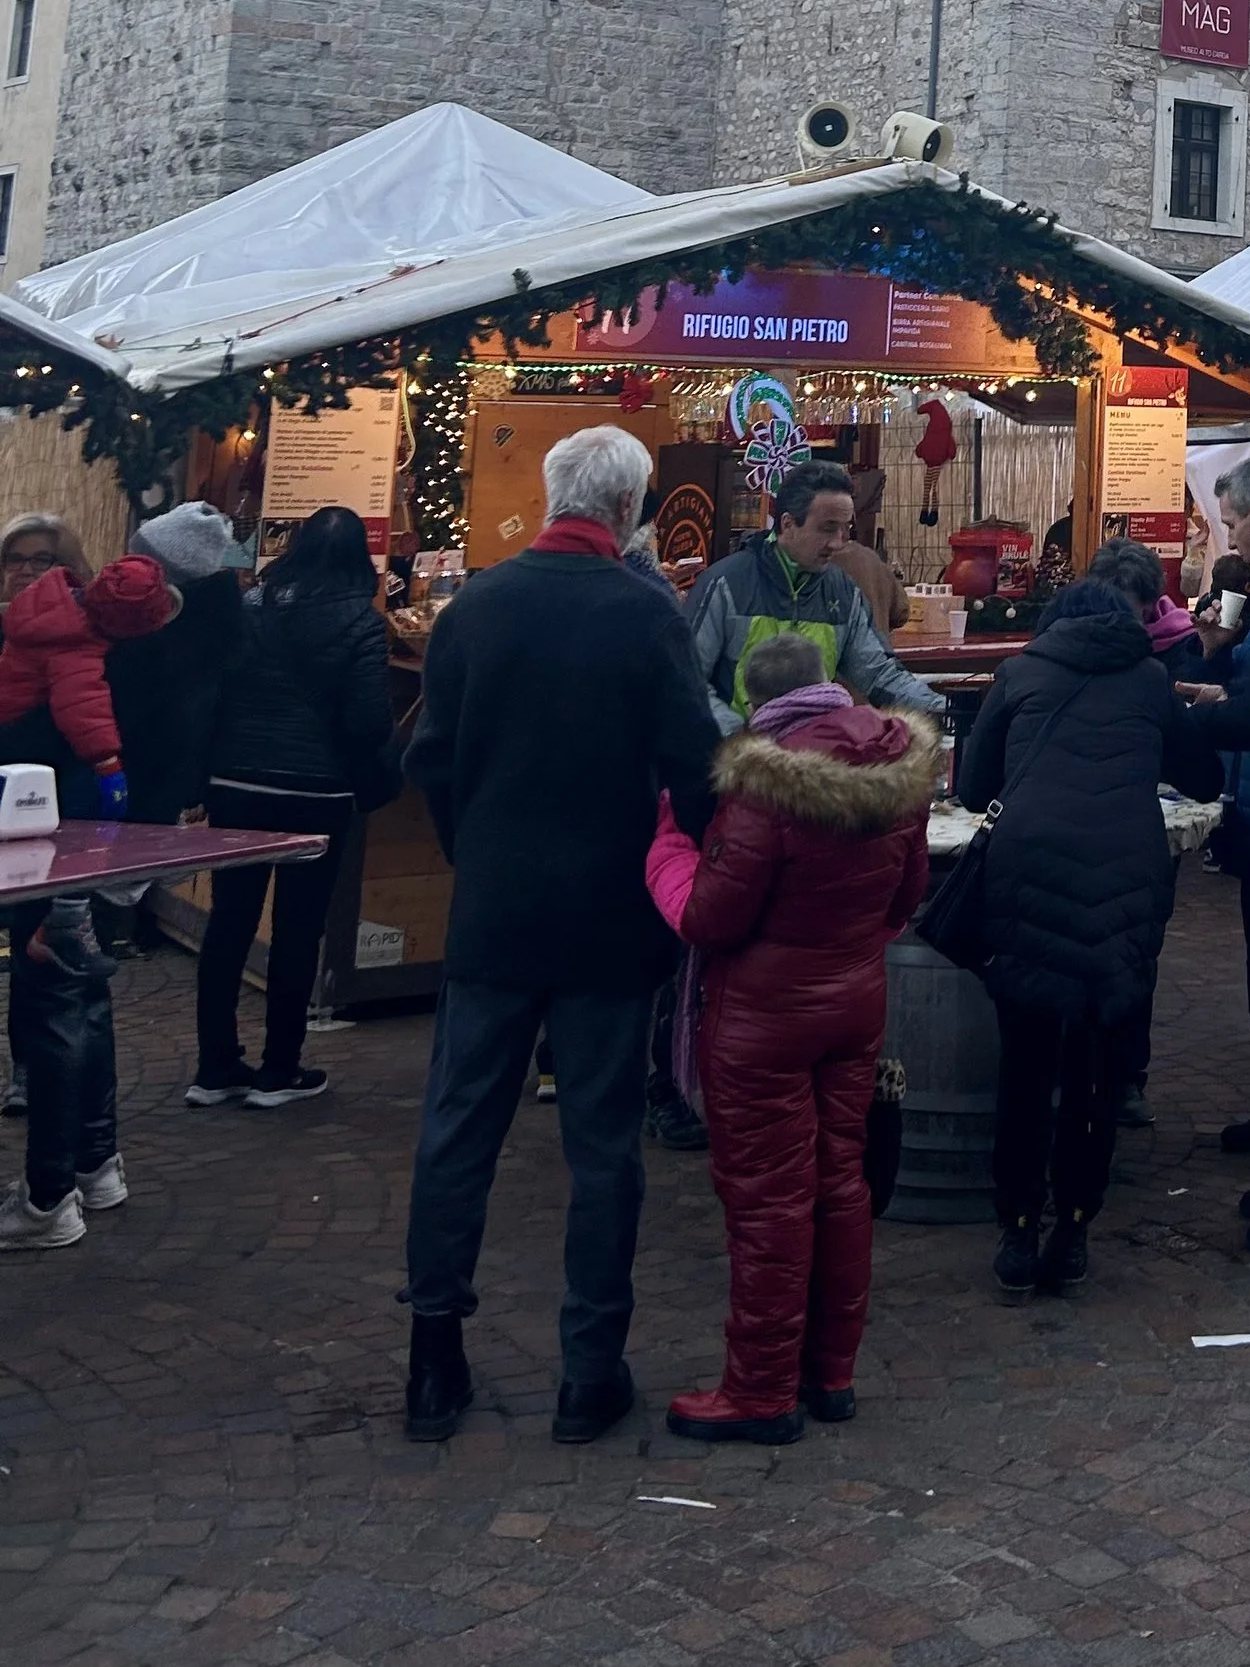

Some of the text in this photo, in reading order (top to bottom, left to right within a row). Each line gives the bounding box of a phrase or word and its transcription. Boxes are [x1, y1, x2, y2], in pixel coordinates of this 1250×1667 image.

[1182, 0, 1231, 34] MAG
[1180, 45, 1198, 55] MUSEO
[683, 313, 849, 343] RIFUGIO SAN PIETRO
[1110, 370, 1127, 394] 11
[1002, 544, 1018, 552] VIN
